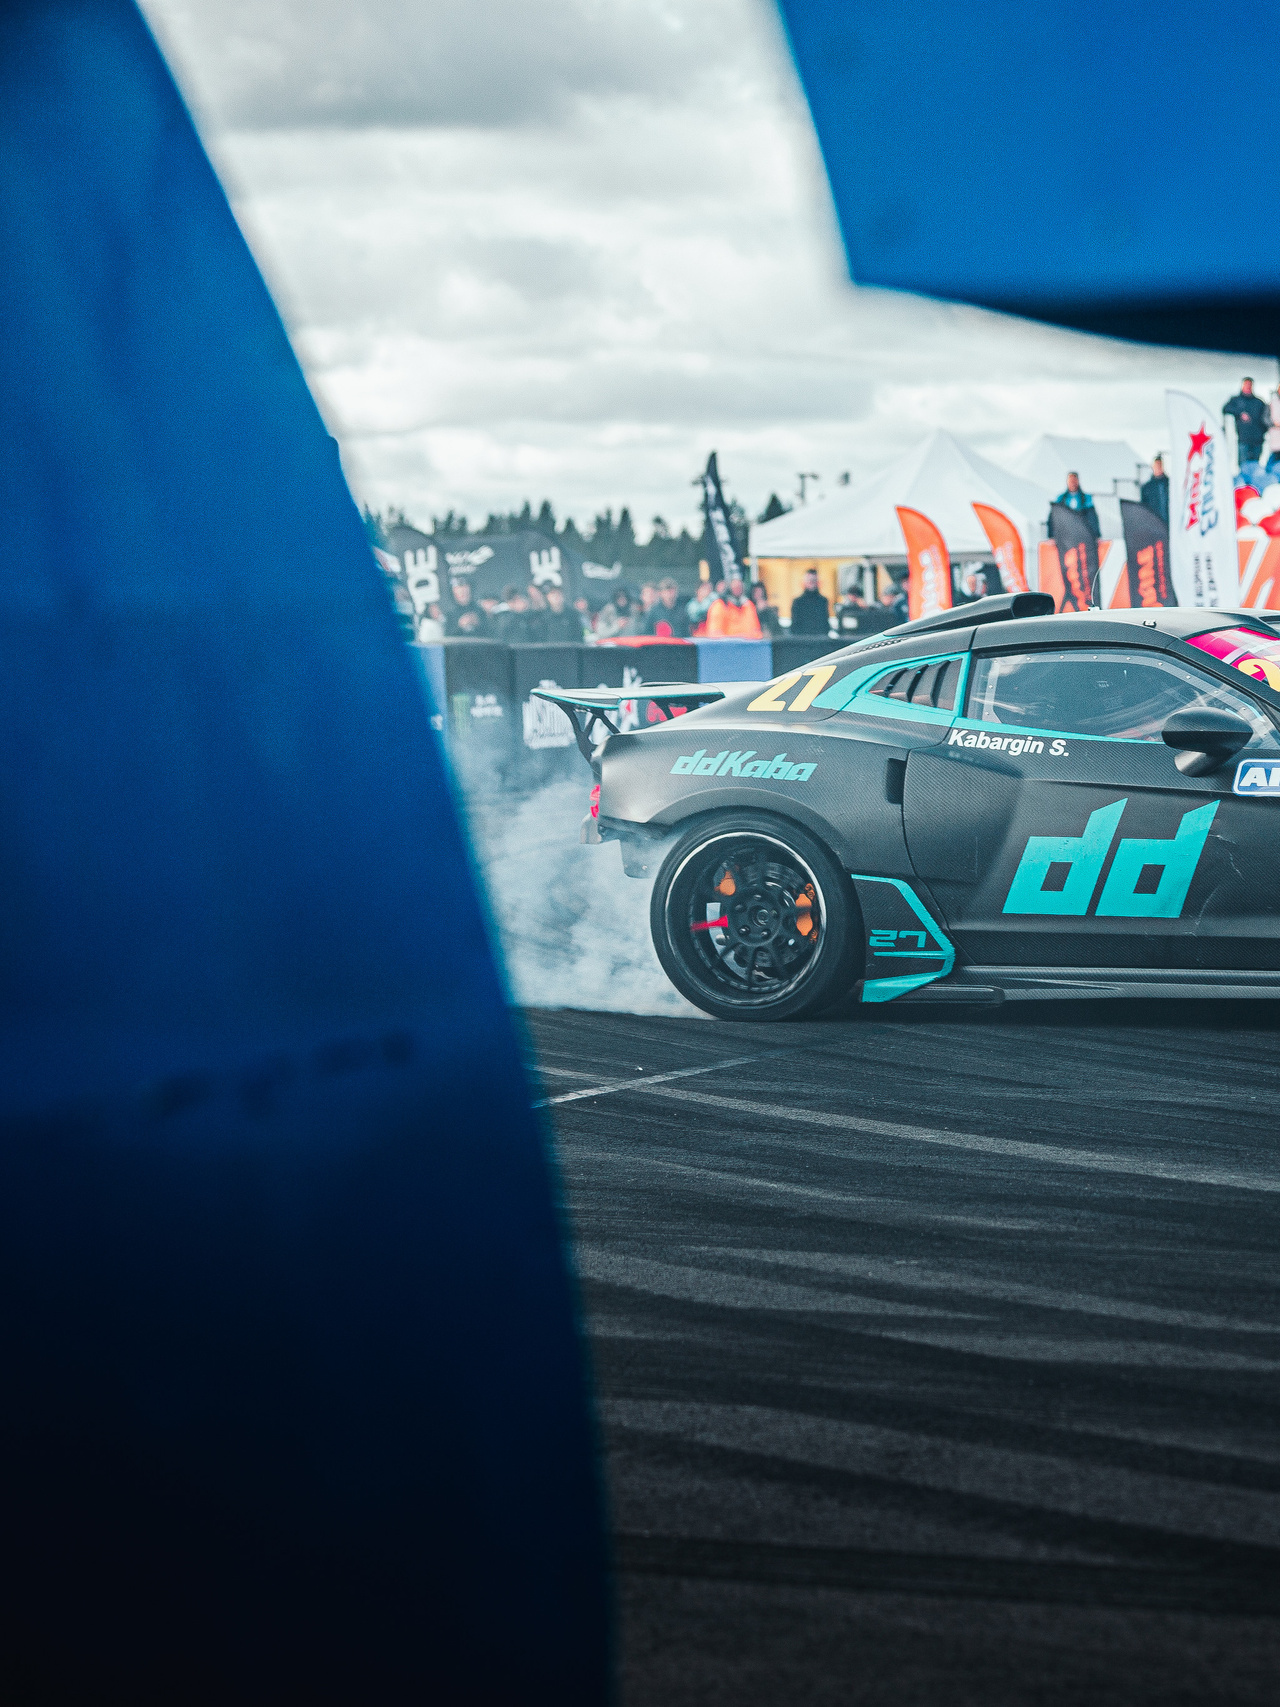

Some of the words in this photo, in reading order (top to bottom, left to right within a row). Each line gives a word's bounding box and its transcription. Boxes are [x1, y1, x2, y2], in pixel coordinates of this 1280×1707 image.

[746, 665, 838, 712] 27
[948, 729, 1045, 756] Kabargin
[1049, 739, 1070, 757] S.
[669, 749, 818, 782] ddKaba
[869, 929, 927, 948] 27
